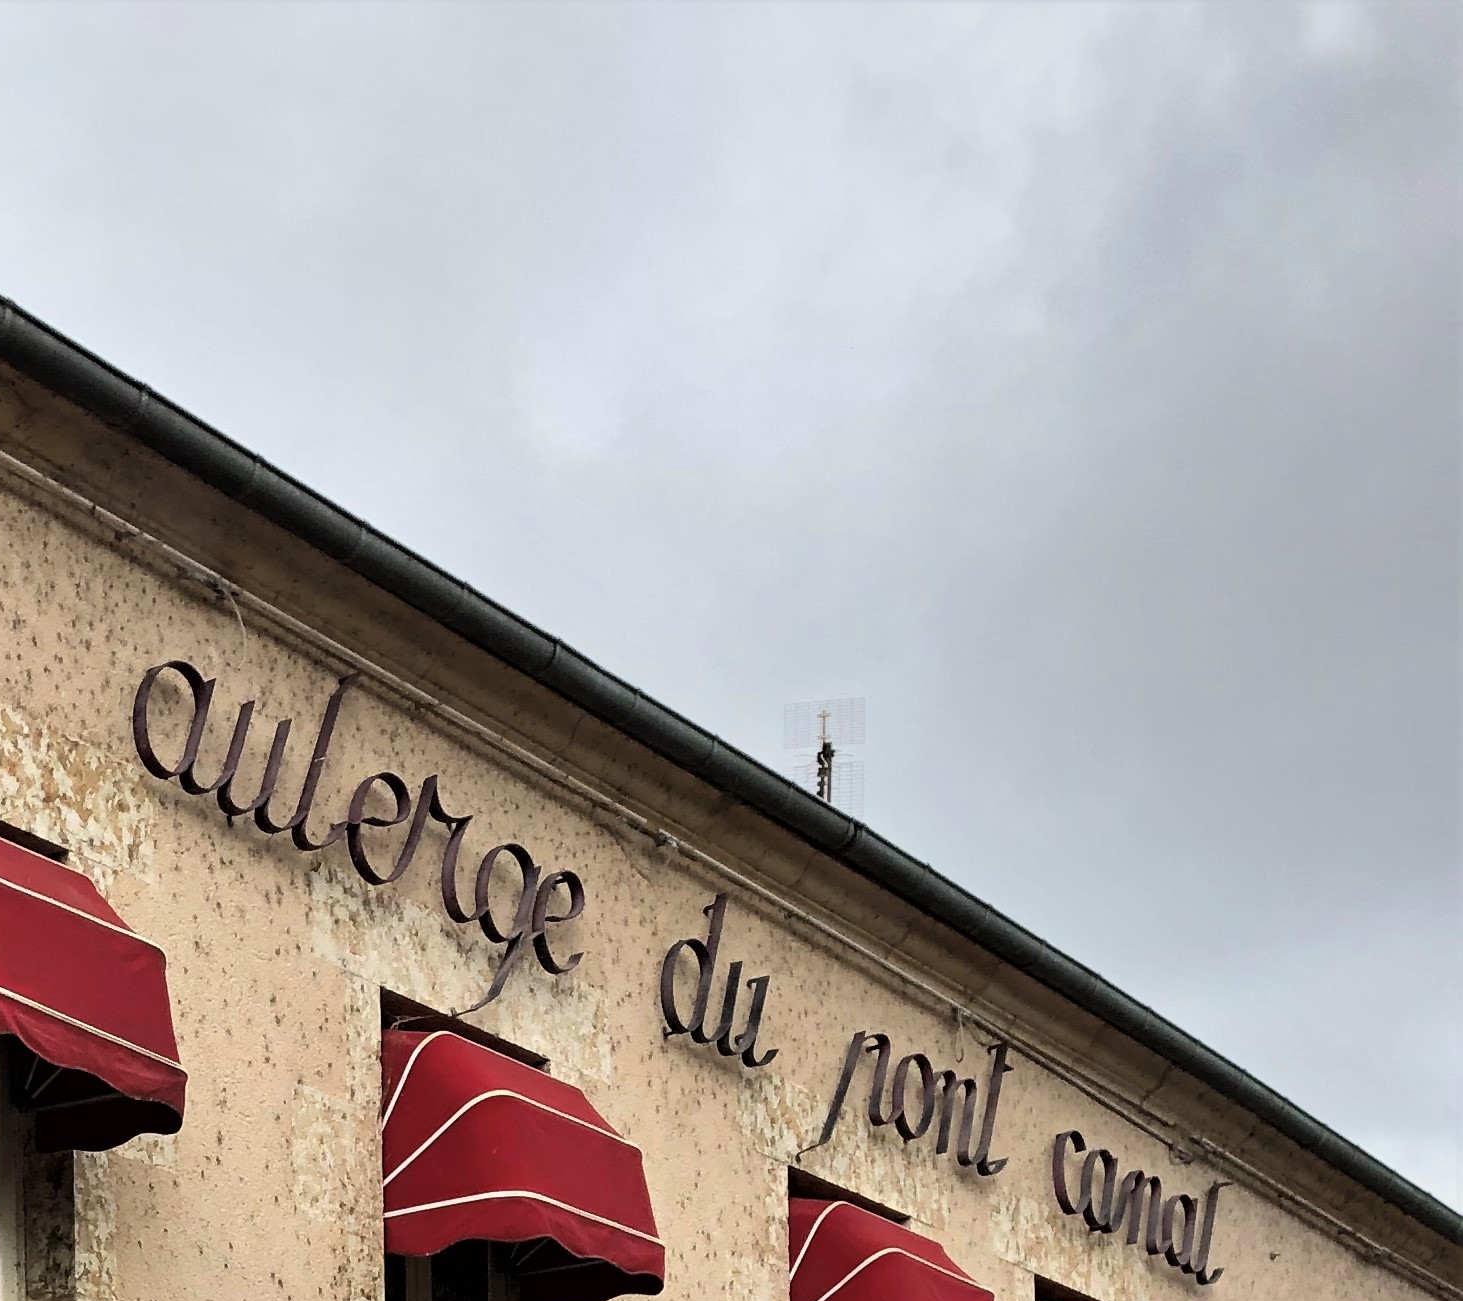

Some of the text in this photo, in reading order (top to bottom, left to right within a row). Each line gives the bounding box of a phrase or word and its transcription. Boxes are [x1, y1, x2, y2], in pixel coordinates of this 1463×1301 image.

[660, 892, 779, 1068] du
[795, 1030, 1014, 1177] pont
[1052, 1130, 1233, 1286] canal
